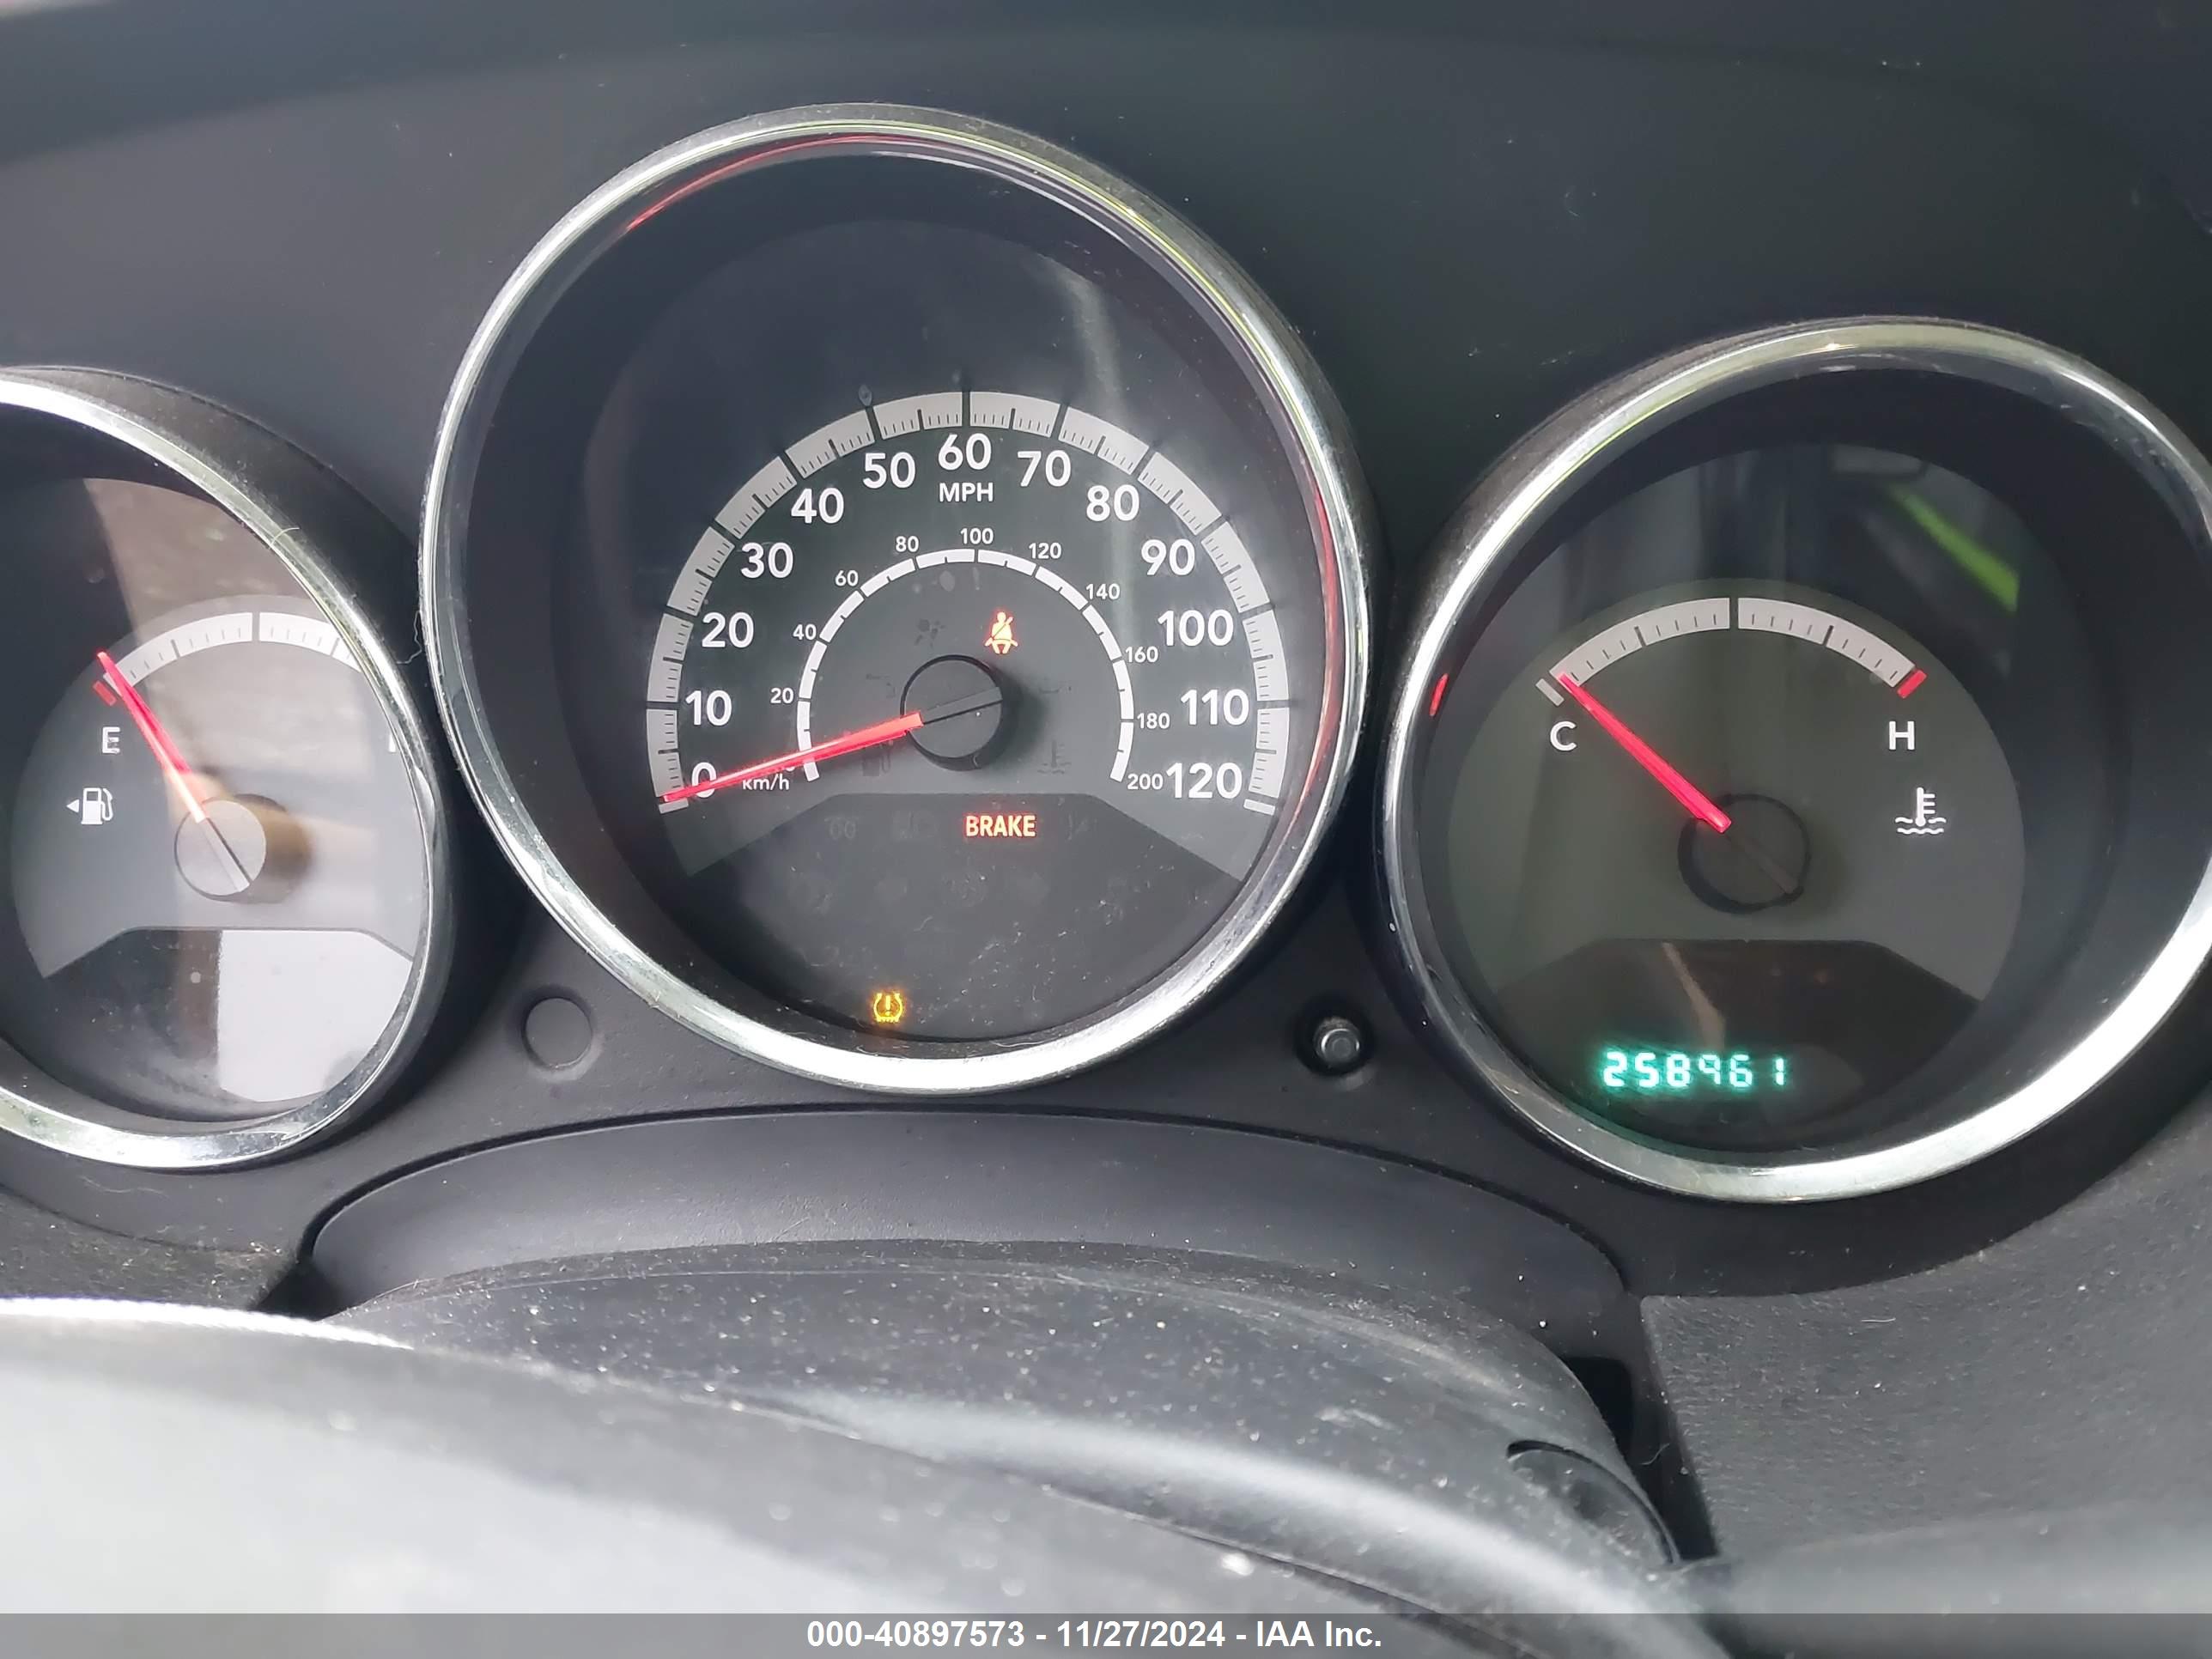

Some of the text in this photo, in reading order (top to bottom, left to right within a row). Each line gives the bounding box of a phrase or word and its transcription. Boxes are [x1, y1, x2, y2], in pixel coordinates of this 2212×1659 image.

[938, 433, 992, 471] 60
[862, 452, 916, 489] 50
[1017, 449, 1072, 487] 70
[790, 487, 844, 524] 40
[939, 483, 994, 502] MPH
[1085, 484, 1139, 522] 80
[895, 535, 920, 552] 80
[960, 527, 994, 544] 100
[1029, 542, 1062, 559] 120
[739, 542, 793, 579] 30
[1140, 538, 1195, 575] 90
[835, 569, 859, 586] 60
[1085, 583, 1121, 600] 140
[701, 611, 754, 648] 20
[793, 623, 817, 641] 40
[1158, 609, 1234, 647] 100
[1124, 646, 1158, 663] 160
[685, 690, 732, 726] 10
[770, 688, 794, 704] 20
[1180, 689, 1249, 726] 110
[1136, 712, 1170, 729] 180
[1550, 720, 1577, 751] C
[1888, 720, 1916, 751] H
[101, 726, 121, 754] E
[691, 762, 717, 799] 0
[742, 773, 790, 791] km/h
[1127, 773, 1164, 790] 200
[1166, 762, 1243, 799] 120
[965, 814, 1036, 837] BRAKE
[1603, 1050, 1787, 1088] 258961
